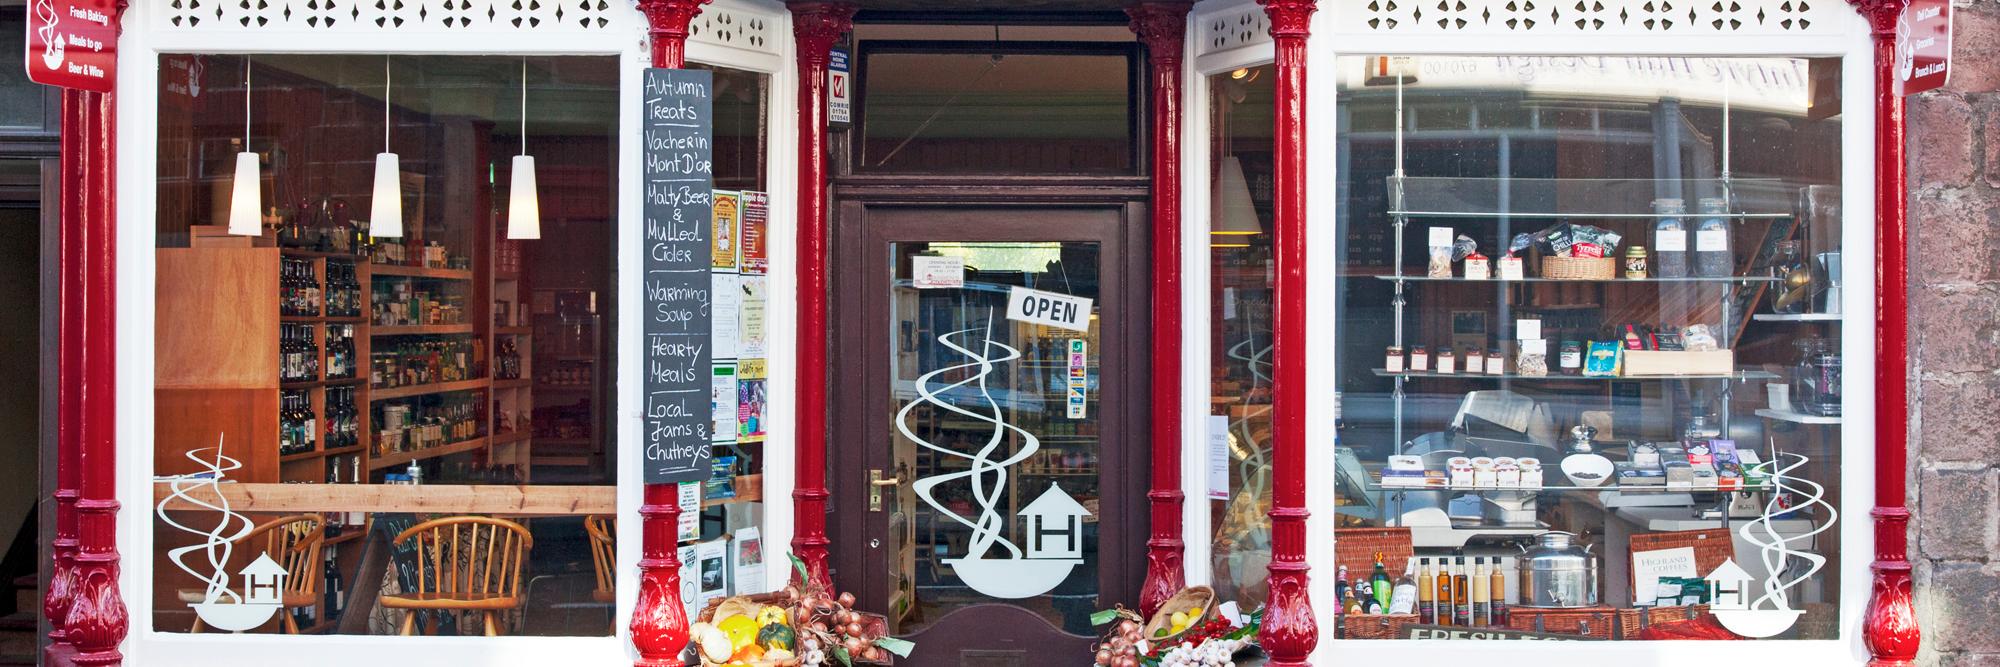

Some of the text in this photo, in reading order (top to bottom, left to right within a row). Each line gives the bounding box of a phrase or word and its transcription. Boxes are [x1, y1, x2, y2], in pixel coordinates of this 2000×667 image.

[70, 6, 108, 26] Fresh Baking
[69, 34, 103, 52] Meals to go
[68, 62, 104, 78] Beer & Wine
[646, 71, 706, 98] Autumn
[646, 97, 697, 120] Treats
[646, 130, 708, 150] Vacherin
[647, 152, 680, 174] Mont
[647, 184, 711, 208] Malty Beer
[673, 208, 684, 223] &
[647, 219, 702, 242] Mulled
[652, 243, 692, 262] Cider
[647, 280, 710, 317] Warming
[1022, 295, 1078, 324] OPEN
[655, 303, 693, 330] Soup
[651, 336, 702, 367] Hearty
[650, 359, 696, 384] Meals
[648, 396, 693, 418] Local
[650, 421, 708, 442] Jams &
[1035, 515, 1075, 551] H
[250, 574, 278, 599] H
[1715, 580, 1742, 604] H
